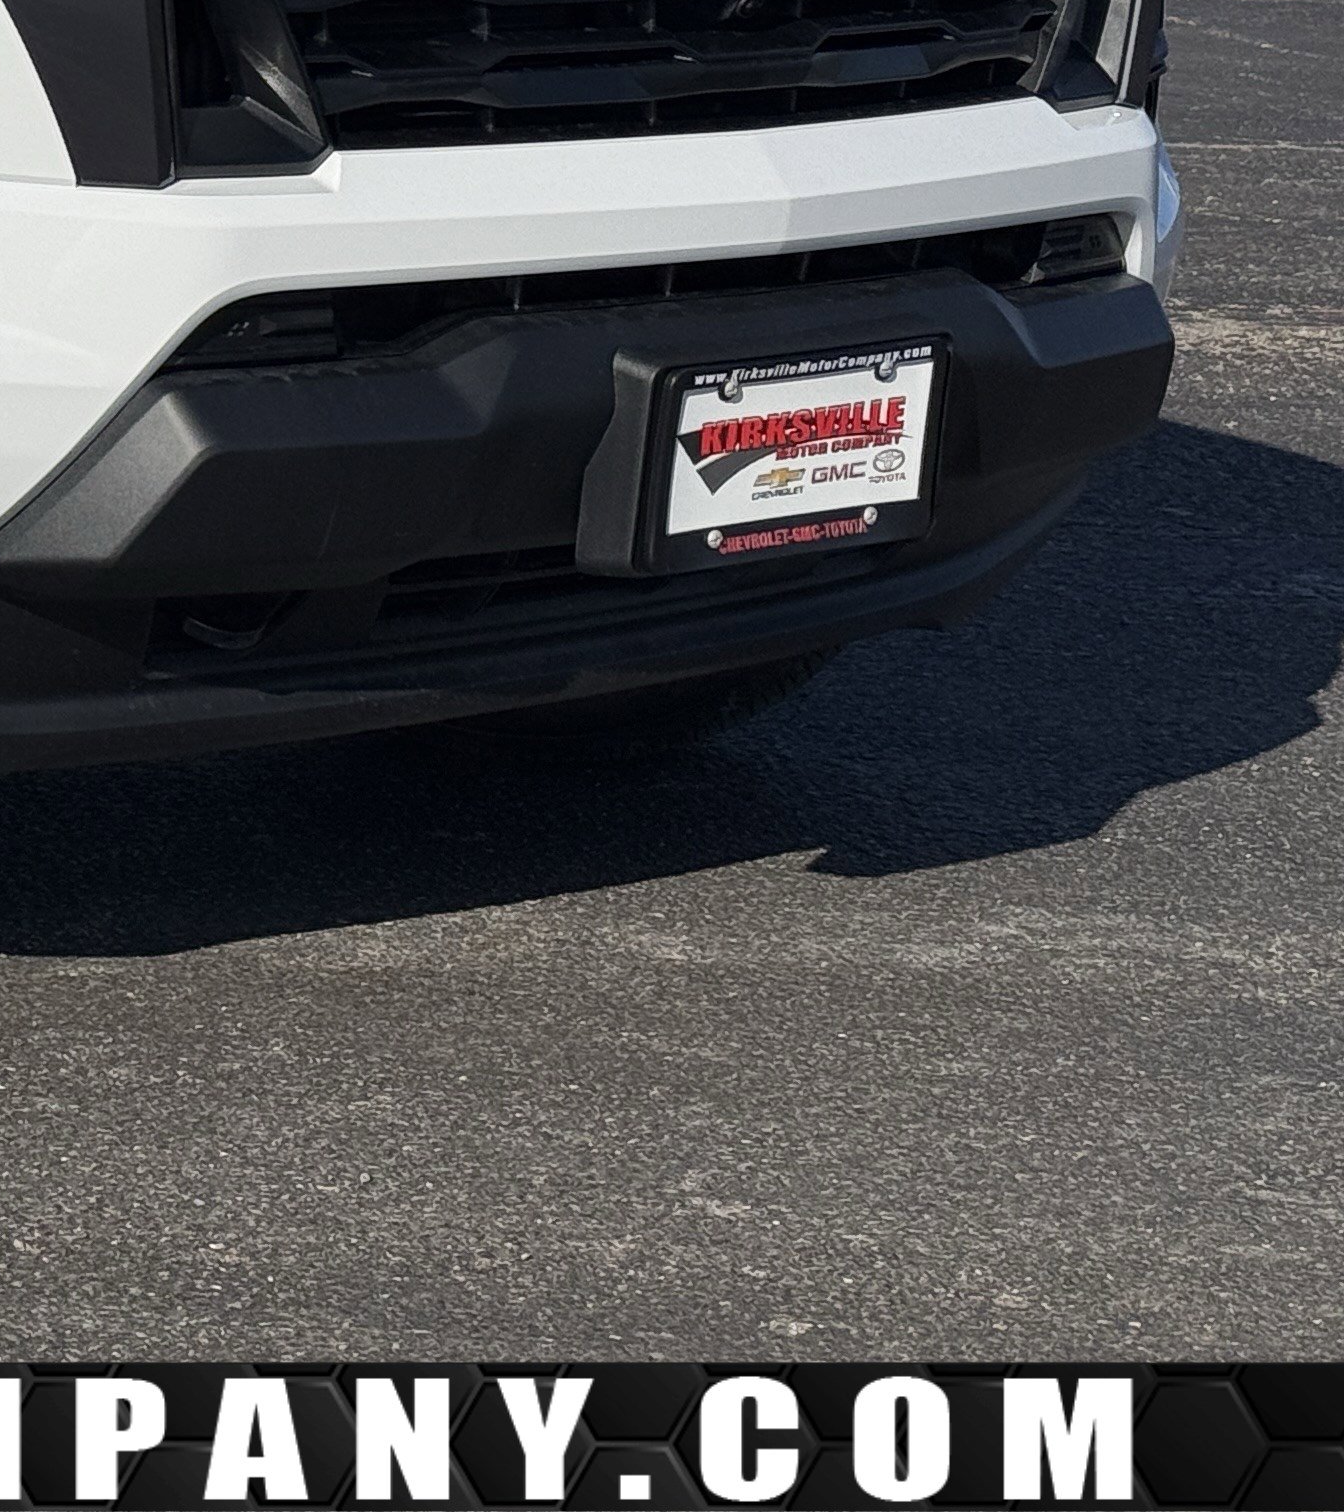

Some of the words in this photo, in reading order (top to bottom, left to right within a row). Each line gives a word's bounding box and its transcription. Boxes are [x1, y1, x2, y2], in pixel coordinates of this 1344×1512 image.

[698, 395, 907, 457] KIRKSVILLE
[775, 441, 828, 462] MOTOR
[831, 432, 902, 454] COMPANY
[811, 461, 868, 485] GMC
[868, 471, 907, 485] TOYOTA
[751, 486, 804, 501] CHEVROLET
